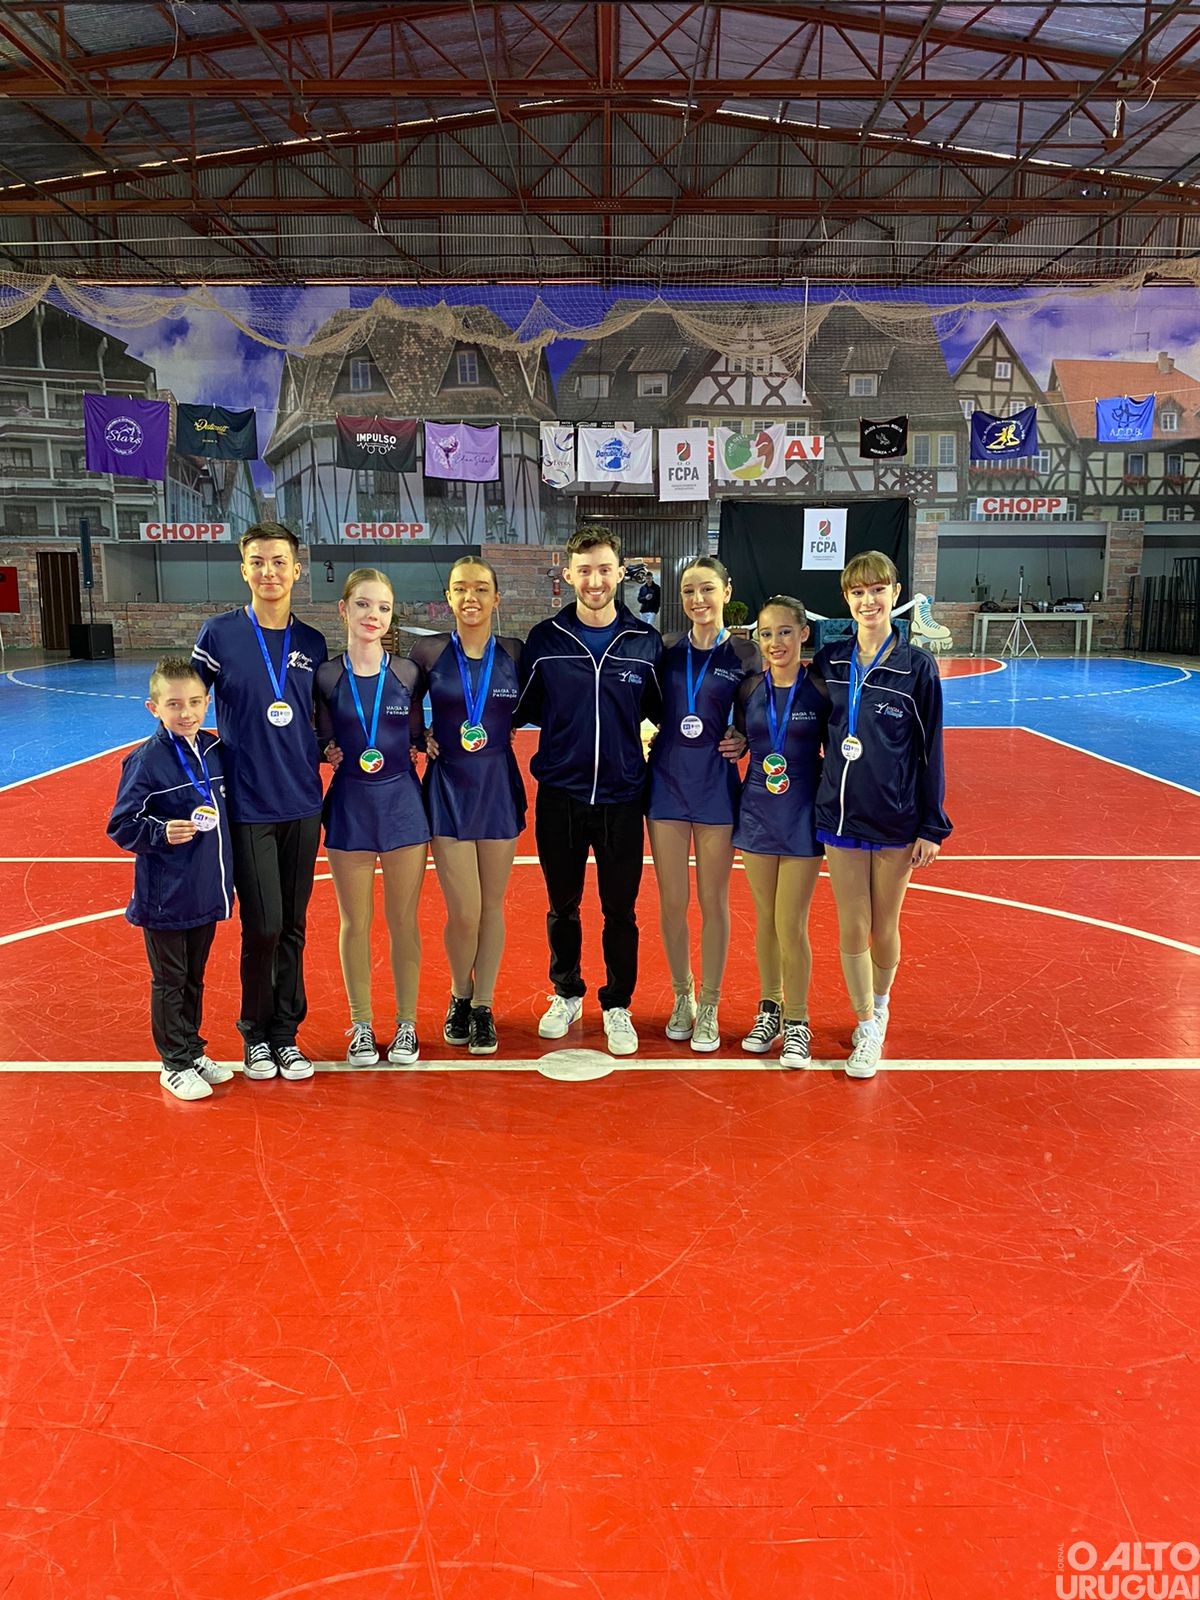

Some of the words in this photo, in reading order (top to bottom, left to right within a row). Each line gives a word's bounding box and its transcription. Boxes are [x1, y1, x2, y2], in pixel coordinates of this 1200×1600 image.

[105, 430, 142, 445] Stars
[356, 433, 397, 444] IMPULSO
[668, 467, 699, 481] FCPA
[983, 498, 1062, 513] CHOPP
[146, 523, 225, 541] CHOPP
[345, 523, 424, 539] CHOPP
[810, 541, 837, 553] FCPA
